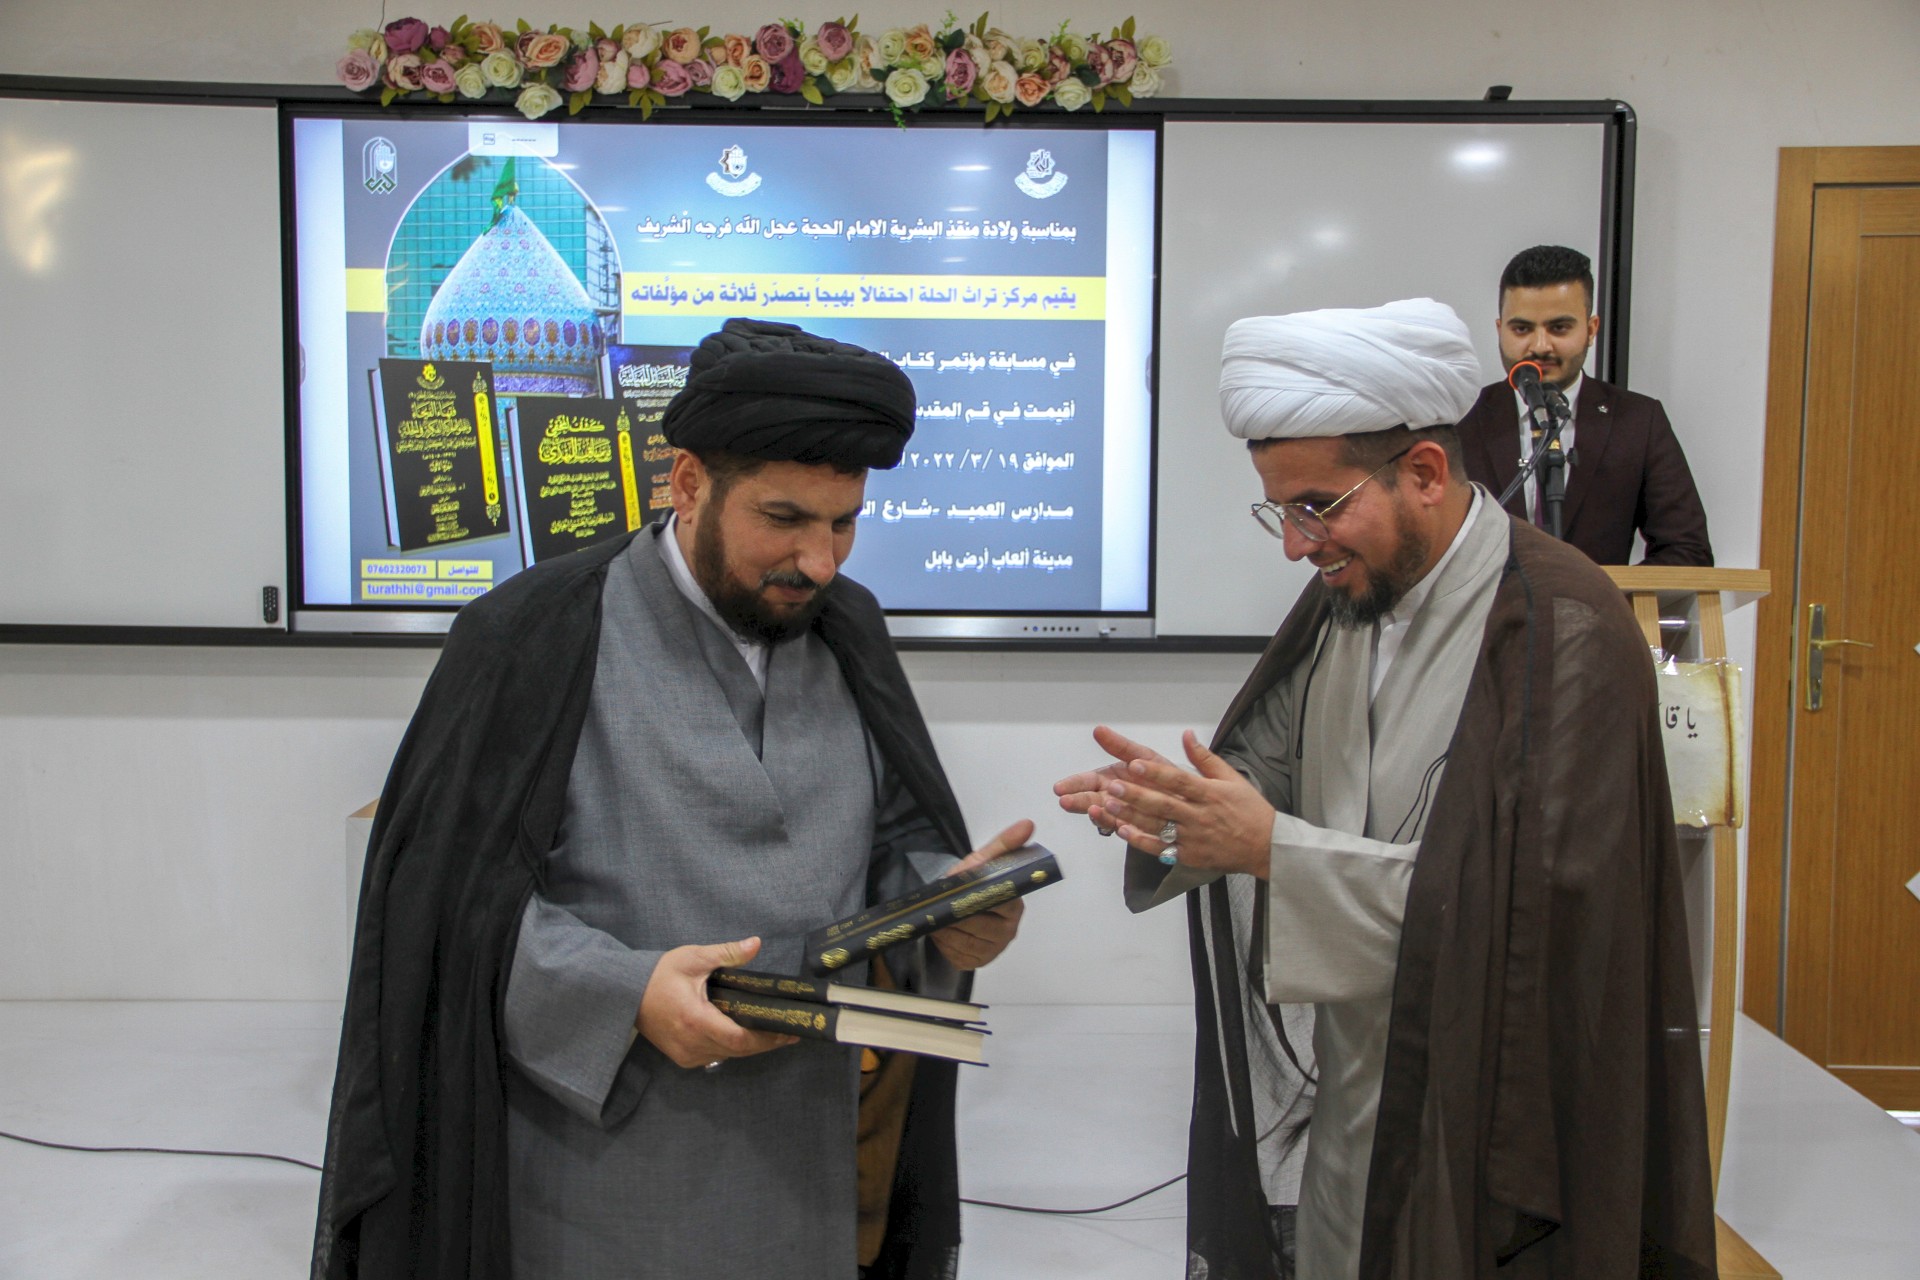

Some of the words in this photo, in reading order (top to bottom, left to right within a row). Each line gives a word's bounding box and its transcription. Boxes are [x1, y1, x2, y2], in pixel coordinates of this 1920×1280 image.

[694, 217, 732, 239] فرجه
[735, 215, 760, 235] الله
[763, 219, 798, 240] عجل
[801, 218, 844, 240] الحجة
[846, 219, 887, 242] الامام
[890, 217, 943, 241] البشرية
[946, 219, 980, 237] منقذ
[983, 220, 1018, 241] ولادة
[1021, 219, 1077, 243] بمناسبة
[692, 289, 715, 305] من
[720, 283, 757, 301] ثلاثة
[918, 286, 957, 303] الحلة
[962, 286, 998, 308] تراث
[1003, 286, 1038, 308] مركز
[1042, 286, 1076, 310] يقيم
[937, 352, 986, 372] مؤتمر
[988, 351, 1047, 373] مسابقة
[1049, 352, 1076, 376] في
[915, 401, 962, 417] المقدس
[964, 401, 991, 424] قم
[993, 401, 1021, 426] في
[1023, 400, 1075, 424] أقيمت
[910, 453, 955, 469] ٢٠٢٢
[998, 453, 1019, 469] ١٩
[1022, 451, 1074, 472] الموافق
[946, 501, 1006, 521] العميد
[1011, 501, 1074, 521] مدارس
[367, 564, 427, 574] 07602320073
[924, 550, 954, 570] بابل
[955, 547, 990, 570] أرض
[991, 547, 1030, 571] ألعاب
[1032, 549, 1073, 571] مدينة
[448, 565, 480, 576] للتواصل
[367, 583, 488, 597] turathhi@gmail.com
[1687, 706, 1698, 739] يا
